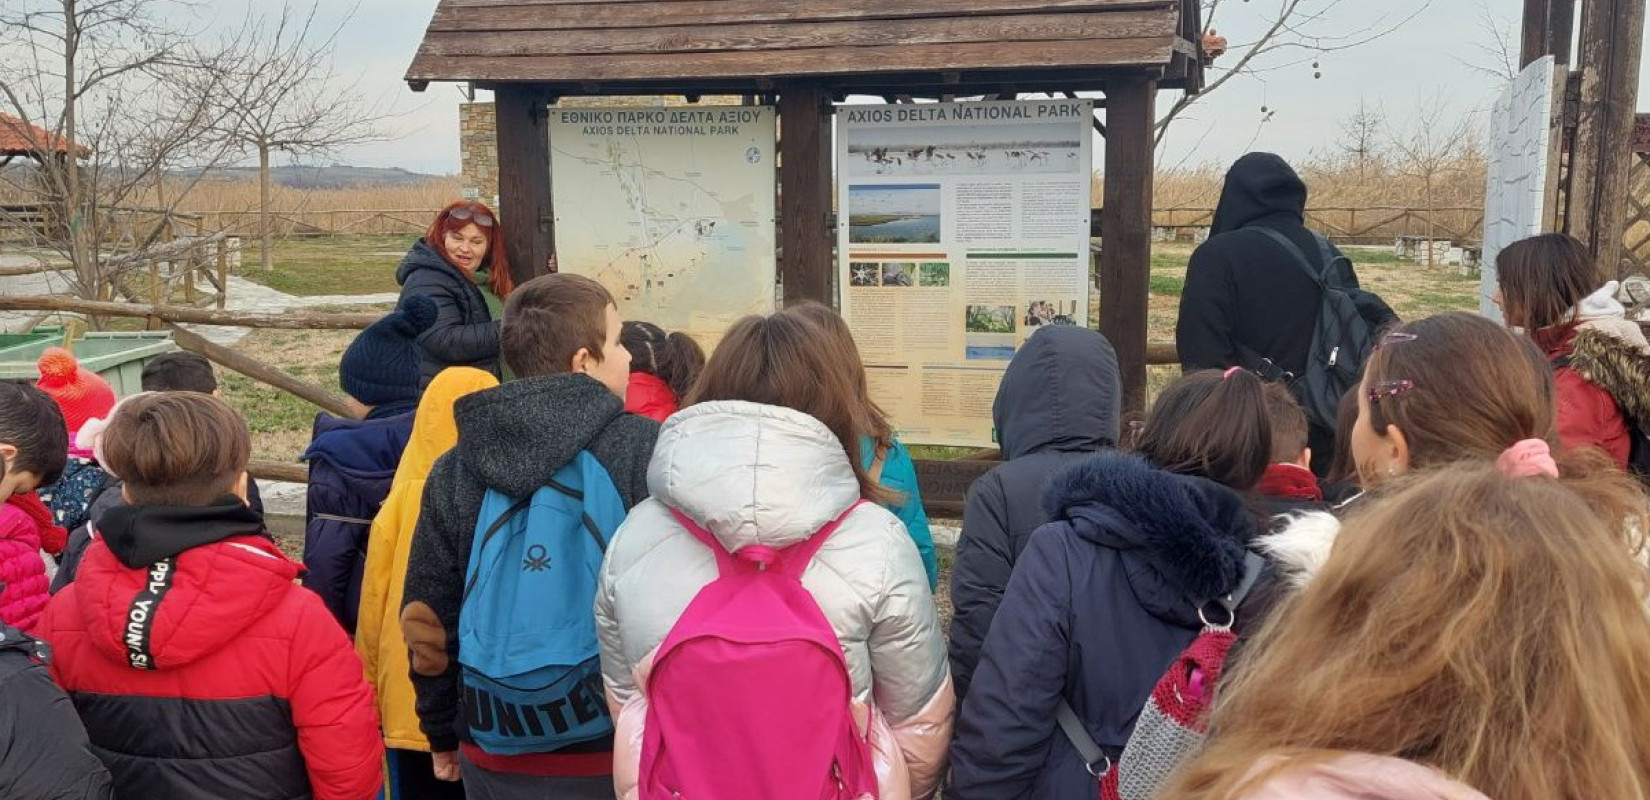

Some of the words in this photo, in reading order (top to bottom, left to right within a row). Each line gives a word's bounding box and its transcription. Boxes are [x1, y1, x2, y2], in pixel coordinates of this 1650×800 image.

[561, 111, 613, 124] ΕΘΝΙΚΟ
[617, 111, 665, 124] ΠΑΡΚΟ
[670, 111, 714, 124] ΔΕΛΤΑ
[719, 111, 761, 124] ΑΞΙΟΥ
[847, 109, 893, 123] AXIOS
[900, 108, 947, 122] DELTA
[953, 105, 1031, 121] NATIONAL
[1038, 103, 1081, 118] PARK
[582, 125, 614, 136] AXIOS
[616, 125, 650, 136] DELTA
[653, 125, 706, 136] NATIONAL
[709, 125, 739, 136] PARK
[126, 600, 153, 653] YOUN
